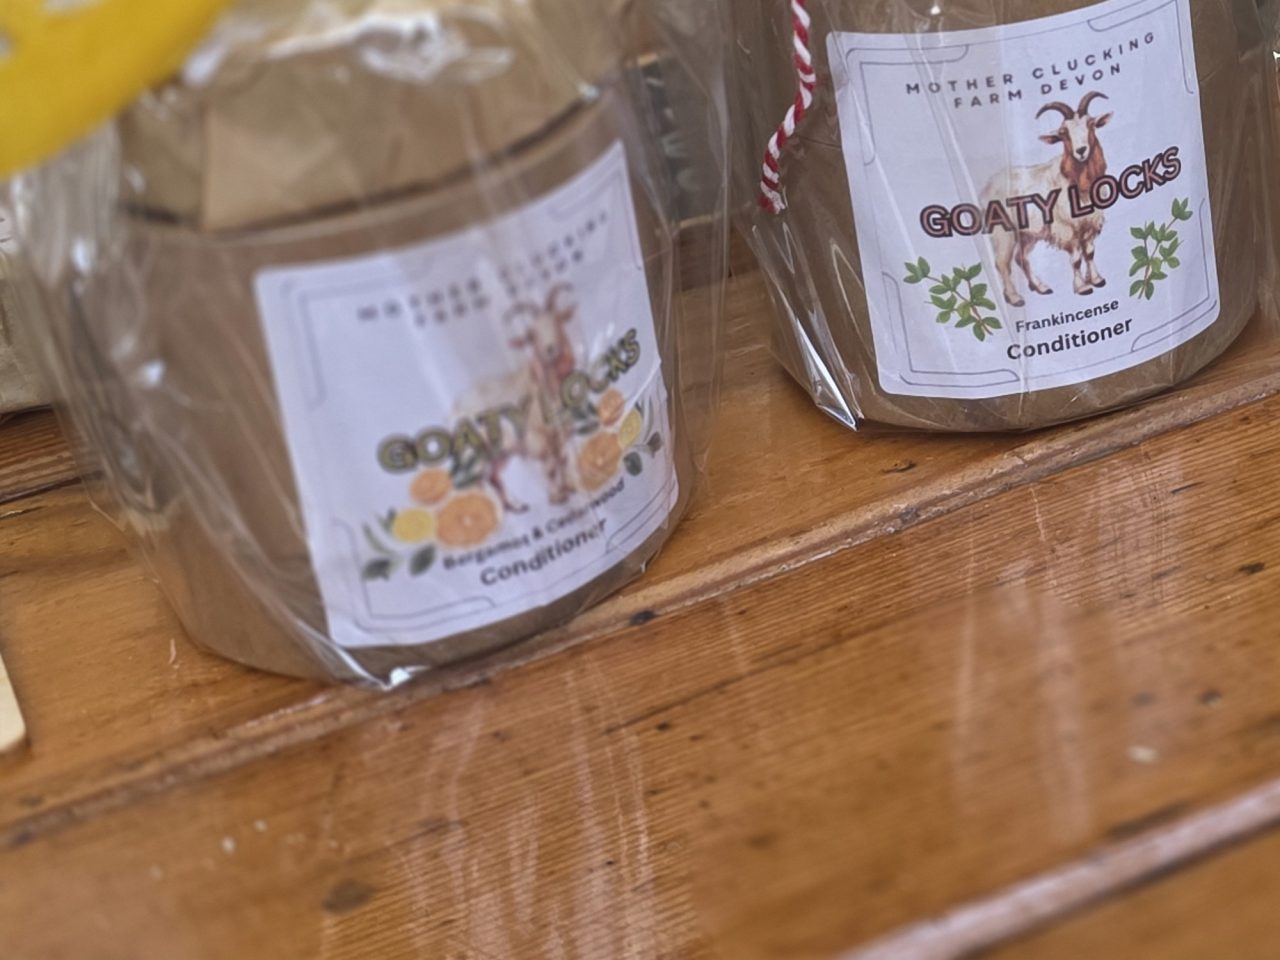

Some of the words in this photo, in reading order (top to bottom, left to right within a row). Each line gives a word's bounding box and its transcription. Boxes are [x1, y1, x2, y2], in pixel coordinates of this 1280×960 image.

[906, 73, 1015, 96] MOTHER
[1033, 32, 1156, 80] CLUCKING
[954, 88, 1023, 109] FARM
[1041, 63, 1122, 96] DEVON
[919, 187, 1061, 239] GOATY
[1069, 145, 1182, 219] LOCKS
[1006, 317, 1133, 361] Conditioner
[1015, 299, 1120, 334] Frankincense
[377, 393, 534, 474] GOATY
[480, 517, 607, 586] Conditioner
